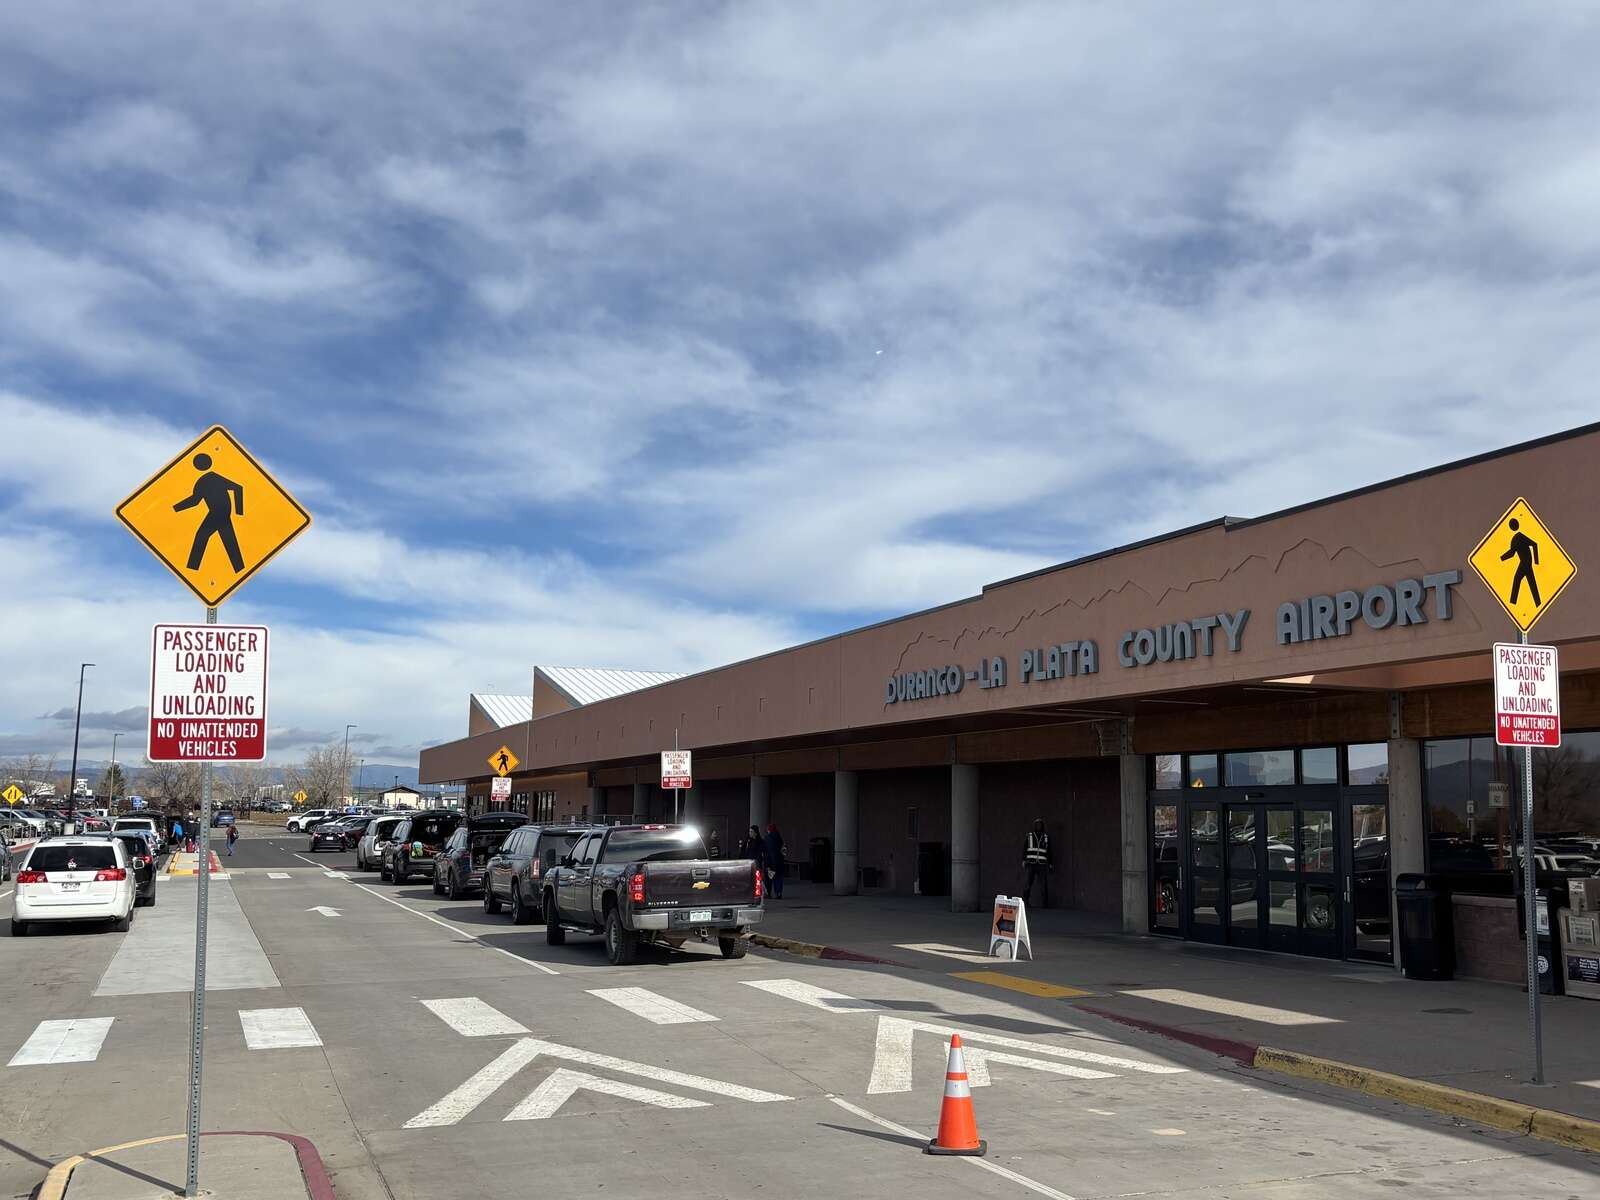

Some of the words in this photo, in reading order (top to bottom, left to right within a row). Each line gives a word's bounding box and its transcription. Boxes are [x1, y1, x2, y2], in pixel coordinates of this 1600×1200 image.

[1020, 640, 1099, 683] PLATA
[1119, 609, 1250, 668] COUNTY
[1276, 569, 1462, 645] AIRPORT
[163, 631, 258, 652] PASSENGER
[176, 652, 244, 673] LOADING
[1500, 649, 1551, 666] PASSENGER
[1507, 665, 1545, 681] LOADING
[193, 674, 226, 694] AND
[1518, 682, 1536, 696] AND
[162, 695, 255, 715] UNLOADING
[1502, 696, 1552, 713] UNLOADING
[157, 722, 174, 738] NO
[181, 722, 258, 738] UNATTENDED
[1500, 716, 1510, 728] NO
[1513, 716, 1555, 730] UNATTENDED
[1512, 730, 1545, 743] VEHICLES
[179, 741, 237, 757] VEHICLES
